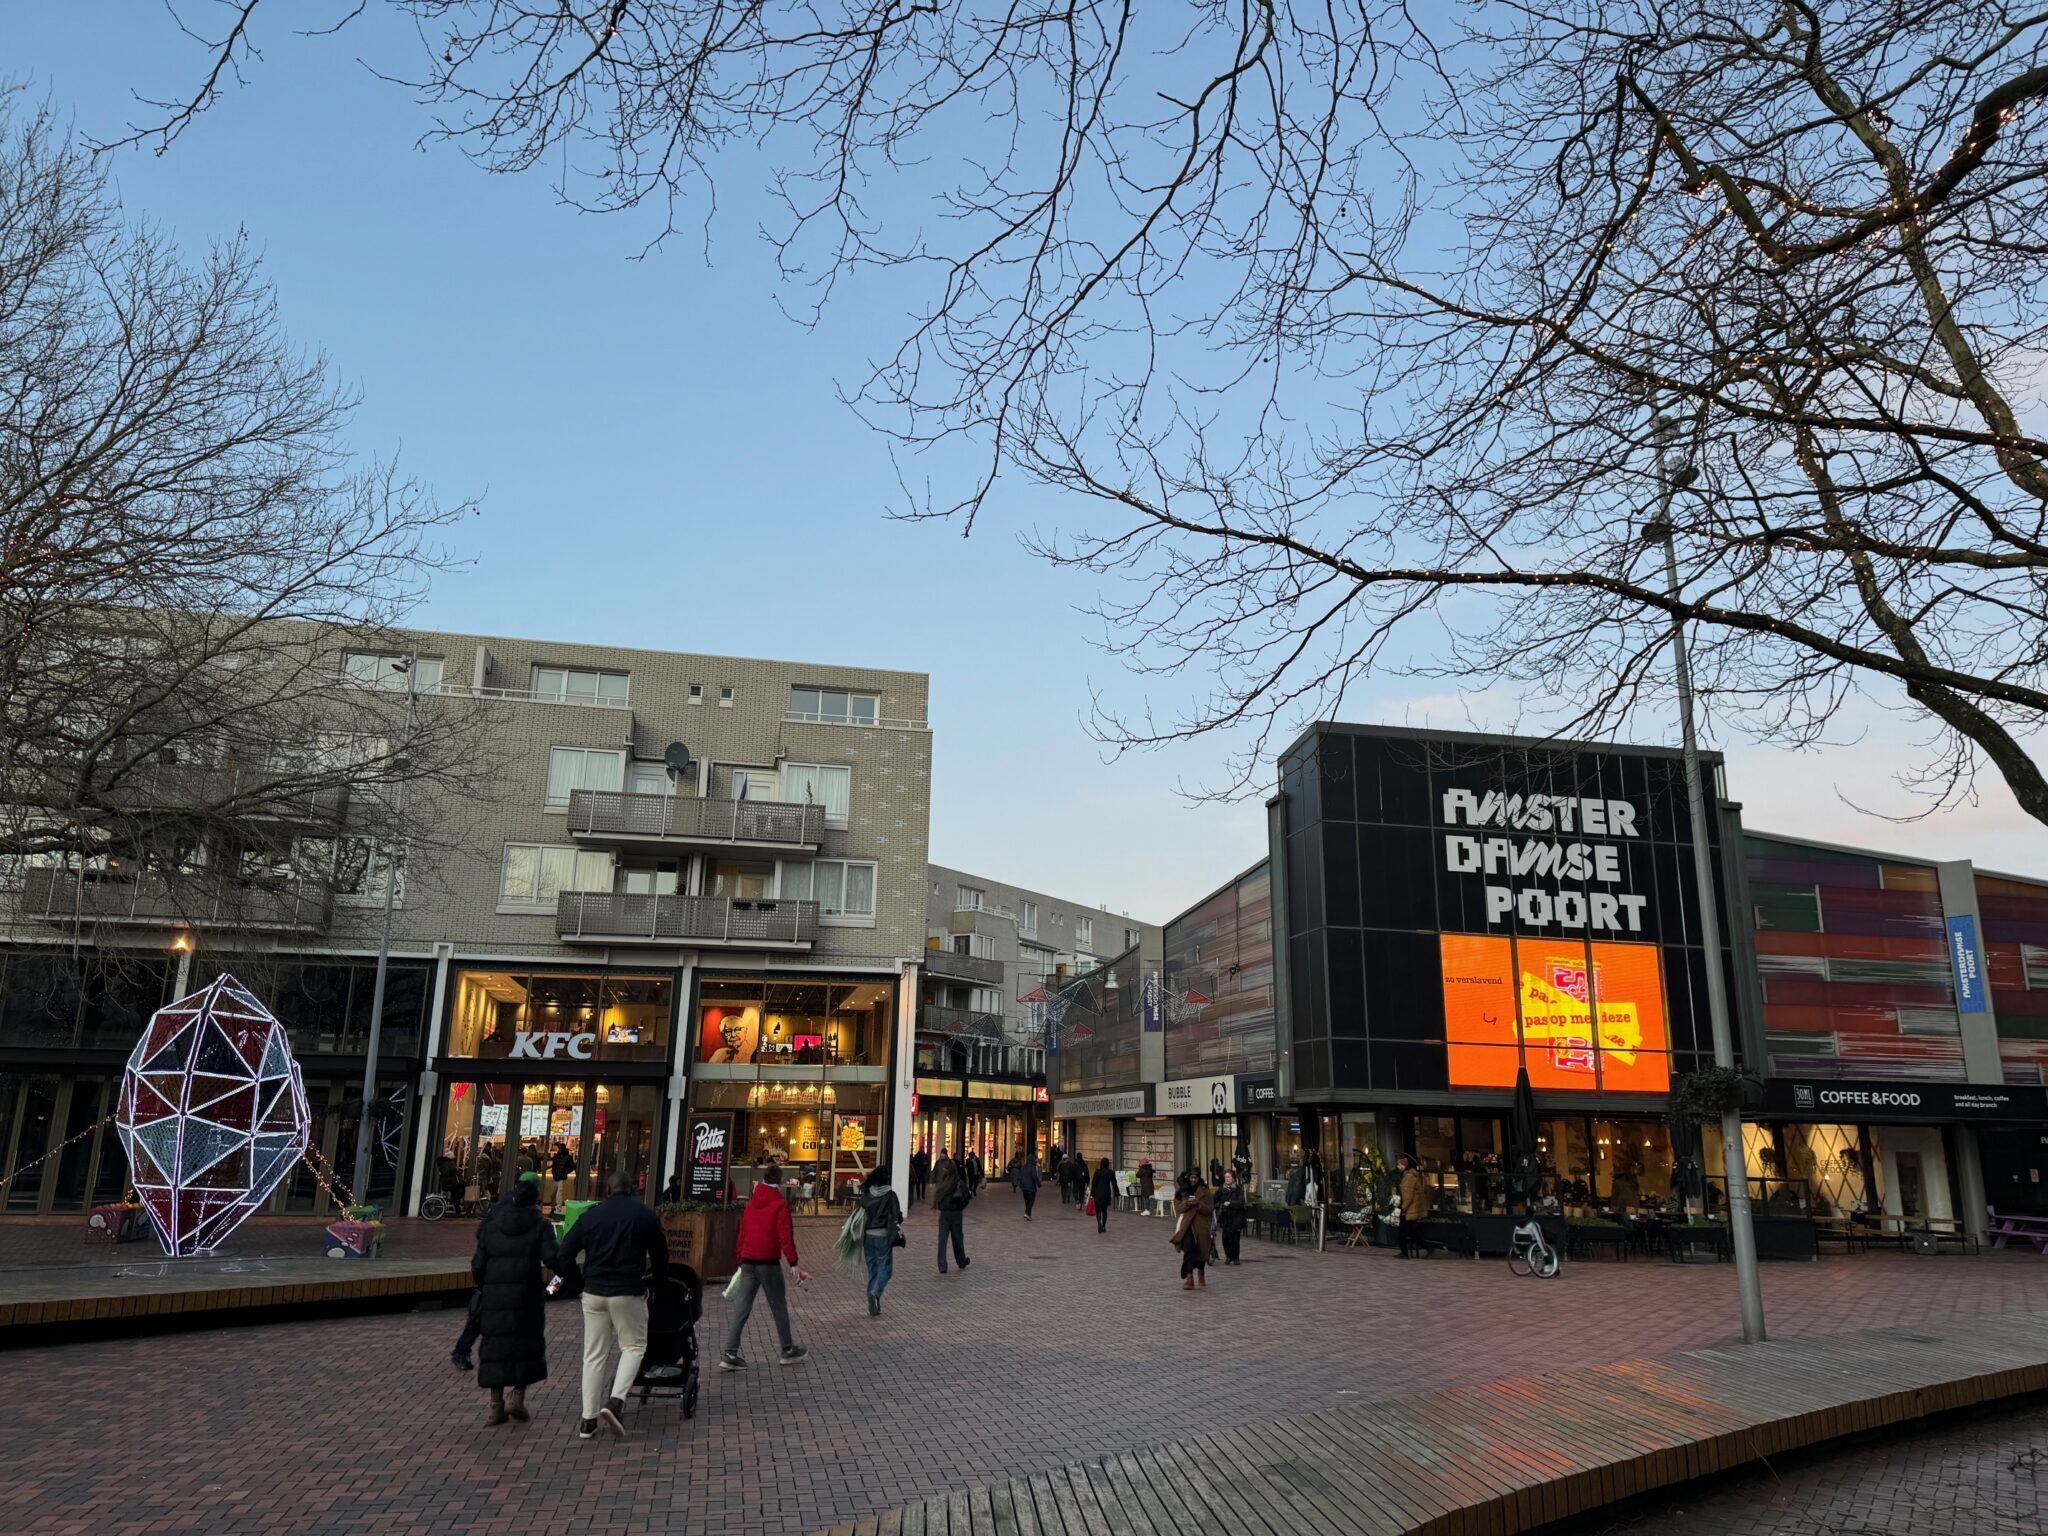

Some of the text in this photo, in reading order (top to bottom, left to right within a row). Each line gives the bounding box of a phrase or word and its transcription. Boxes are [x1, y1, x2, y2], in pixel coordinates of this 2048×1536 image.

[1443, 788, 1640, 837] AMSTER
[1445, 835, 1621, 882] DAMSE
[1486, 885, 1647, 931] POORT
[1965, 949, 1976, 978] POORT
[1550, 1014, 1567, 1027] op
[1570, 1014, 1592, 1024] me
[1601, 1011, 1631, 1023] deze
[509, 1031, 596, 1060] KFC
[1168, 1086, 1191, 1099] BUBBLE
[1256, 1088, 1275, 1099] COFFEE
[1820, 1091, 1870, 1104] COFFEE
[694, 1122, 725, 1158] Patta
[699, 1152, 722, 1164] SALE
